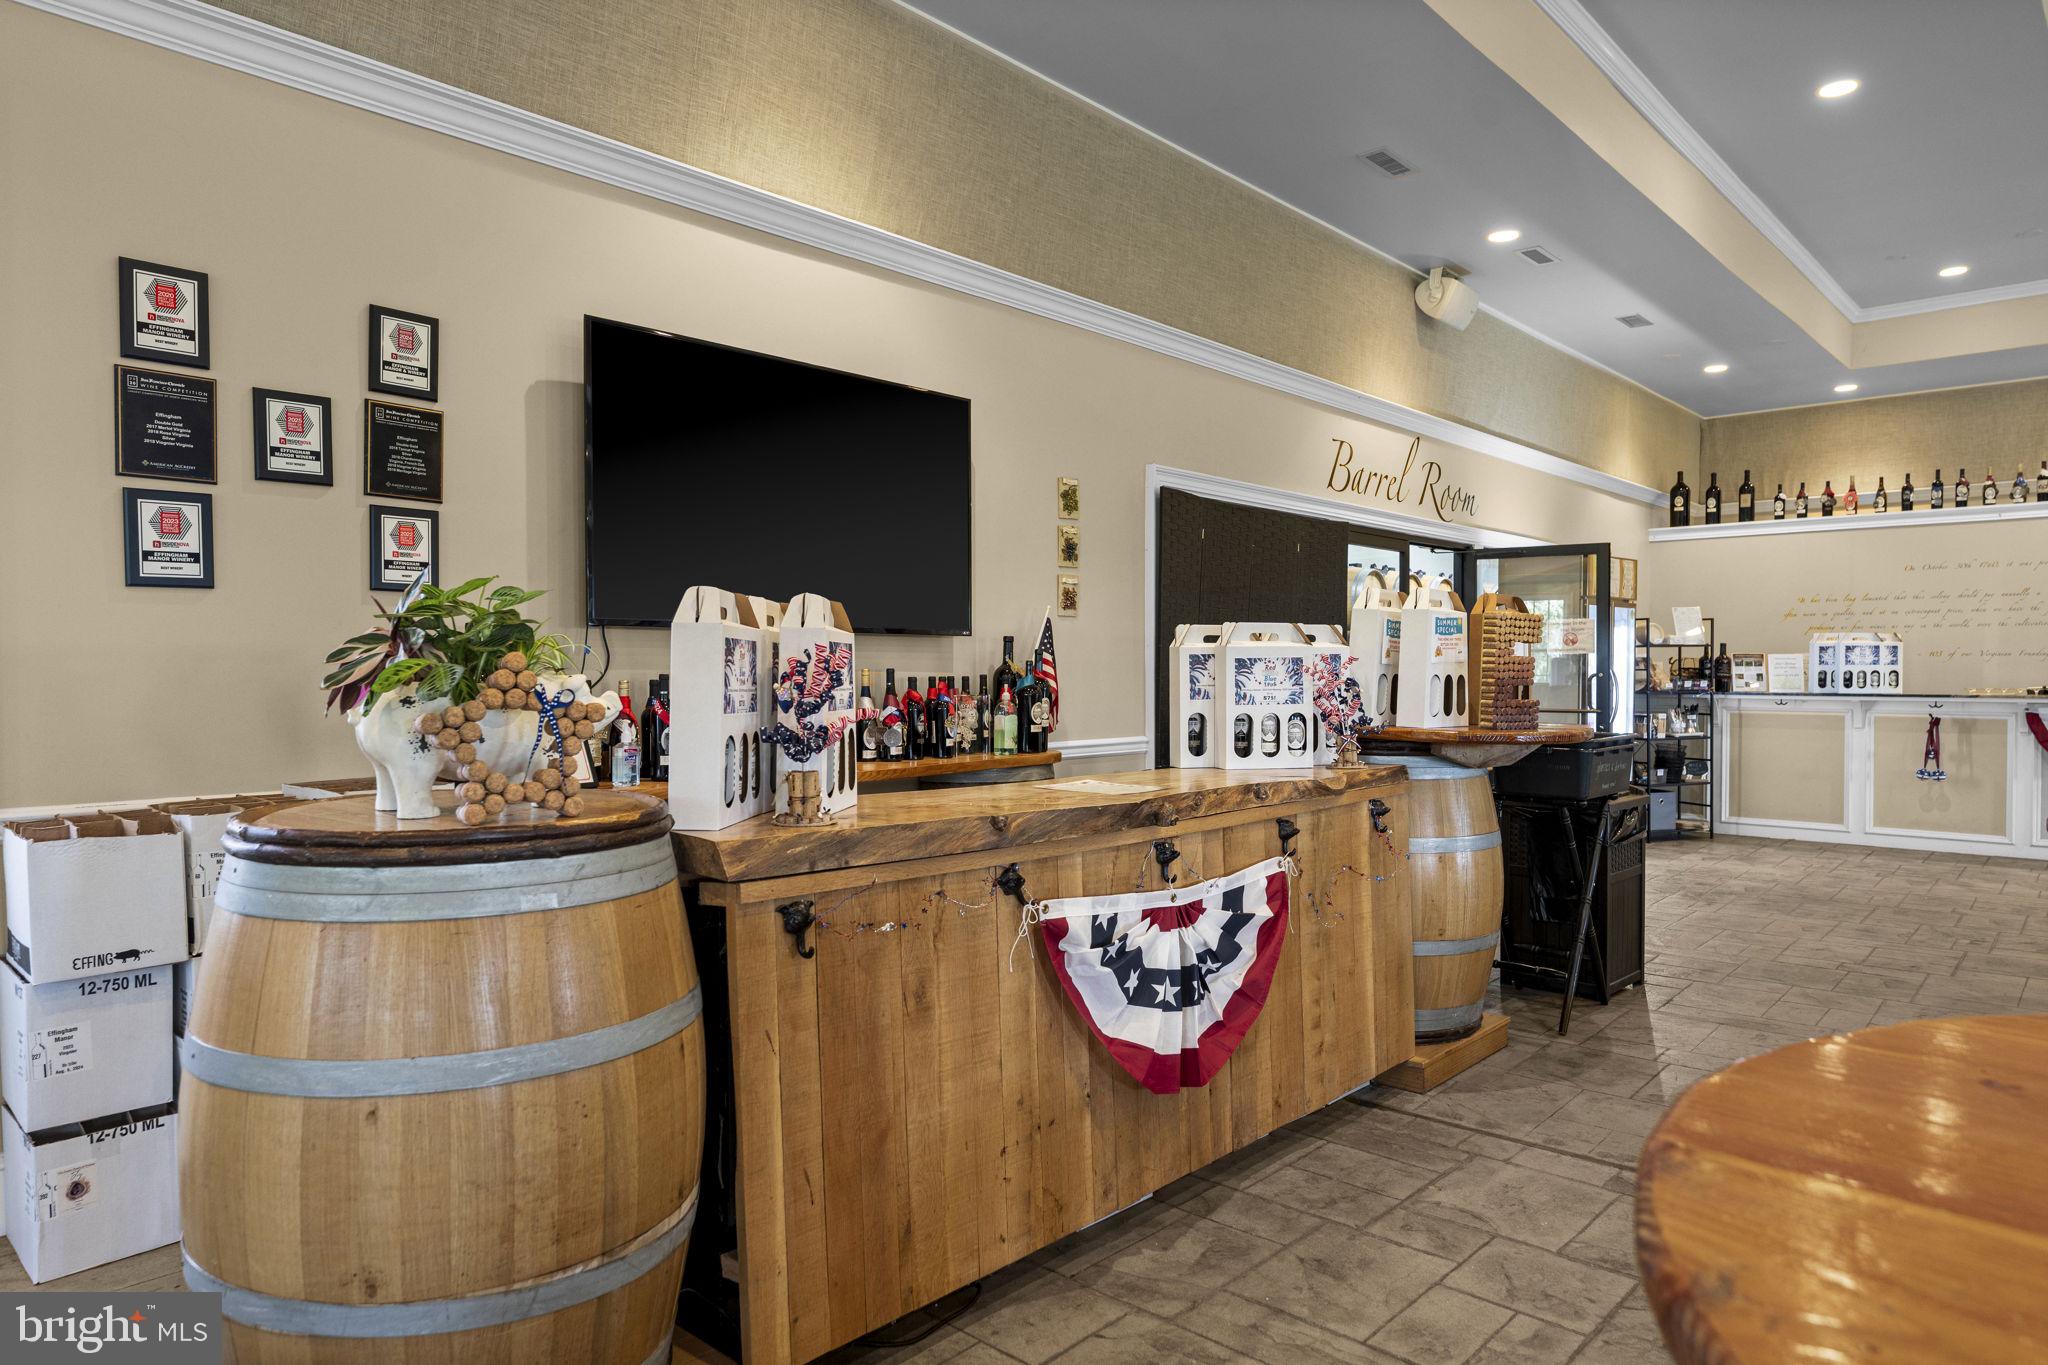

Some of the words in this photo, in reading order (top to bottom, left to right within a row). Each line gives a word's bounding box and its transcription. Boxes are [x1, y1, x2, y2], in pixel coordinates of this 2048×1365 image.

[158, 291, 174, 299] 2020
[143, 328, 165, 336] MANOR
[167, 331, 190, 340] WINERY
[149, 324, 183, 334] EFFINGHAM
[162, 387, 208, 396] COMPETITION
[155, 412, 182, 420] Effingham
[402, 417, 438, 426] COMPETITION
[1327, 437, 1420, 503] Barrel
[1419, 461, 1479, 523] Room
[73, 953, 114, 970] EFFING
[78, 976, 129, 996] 12-750
[134, 973, 157, 988] ML
[48, 1027, 78, 1037] Effingham
[54, 1035, 73, 1043] Manor
[86, 1123, 137, 1144] 12-750
[142, 1118, 165, 1132] ML
